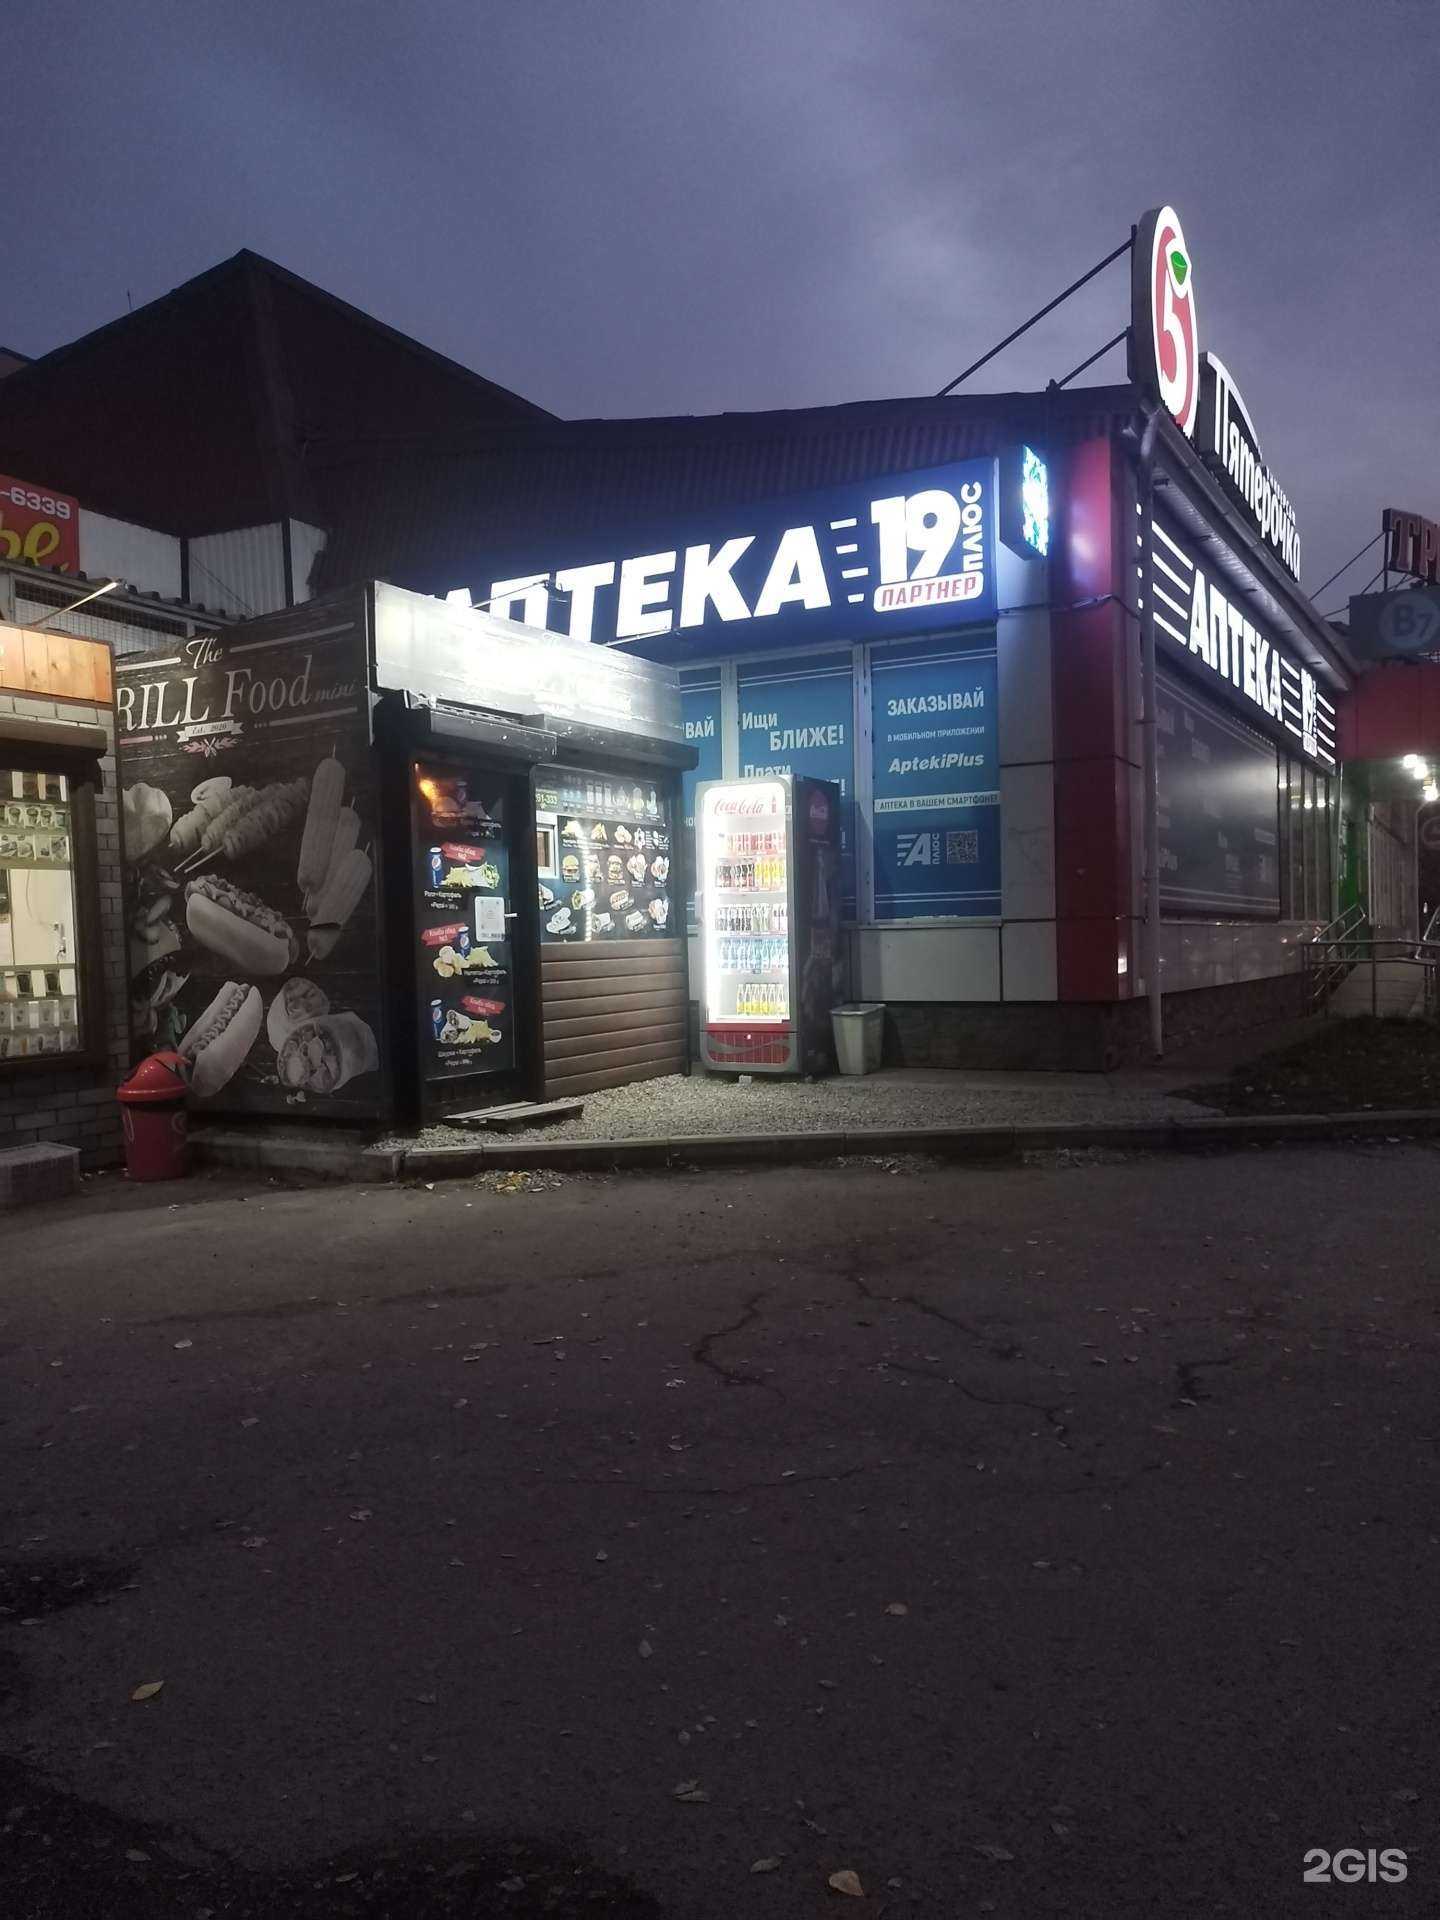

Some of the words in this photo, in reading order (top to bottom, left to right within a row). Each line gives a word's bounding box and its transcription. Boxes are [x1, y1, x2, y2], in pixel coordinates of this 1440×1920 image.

[1208, 352, 1300, 582] Пятерочка
[871, 490, 961, 584] 19
[960, 481, 984, 572] ПЛЮС
[1391, 508, 1440, 586] ТР
[446, 525, 832, 642] ПТЕКА
[881, 576, 977, 607] ПАРТНЕР
[185, 637, 223, 669] The
[1189, 569, 1283, 722] АПТЕКА
[221, 654, 312, 718] Food
[887, 687, 985, 716] ЗАКАЗЫВАЙ
[683, 716, 715, 739] ВАЙ
[742, 712, 778, 732] Ищи
[770, 724, 845, 751] БЛИЖЕ!
[888, 752, 985, 775] AptekiPlus
[879, 799, 909, 810] АПТЕКА
[916, 797, 945, 808] ВАШЕМ
